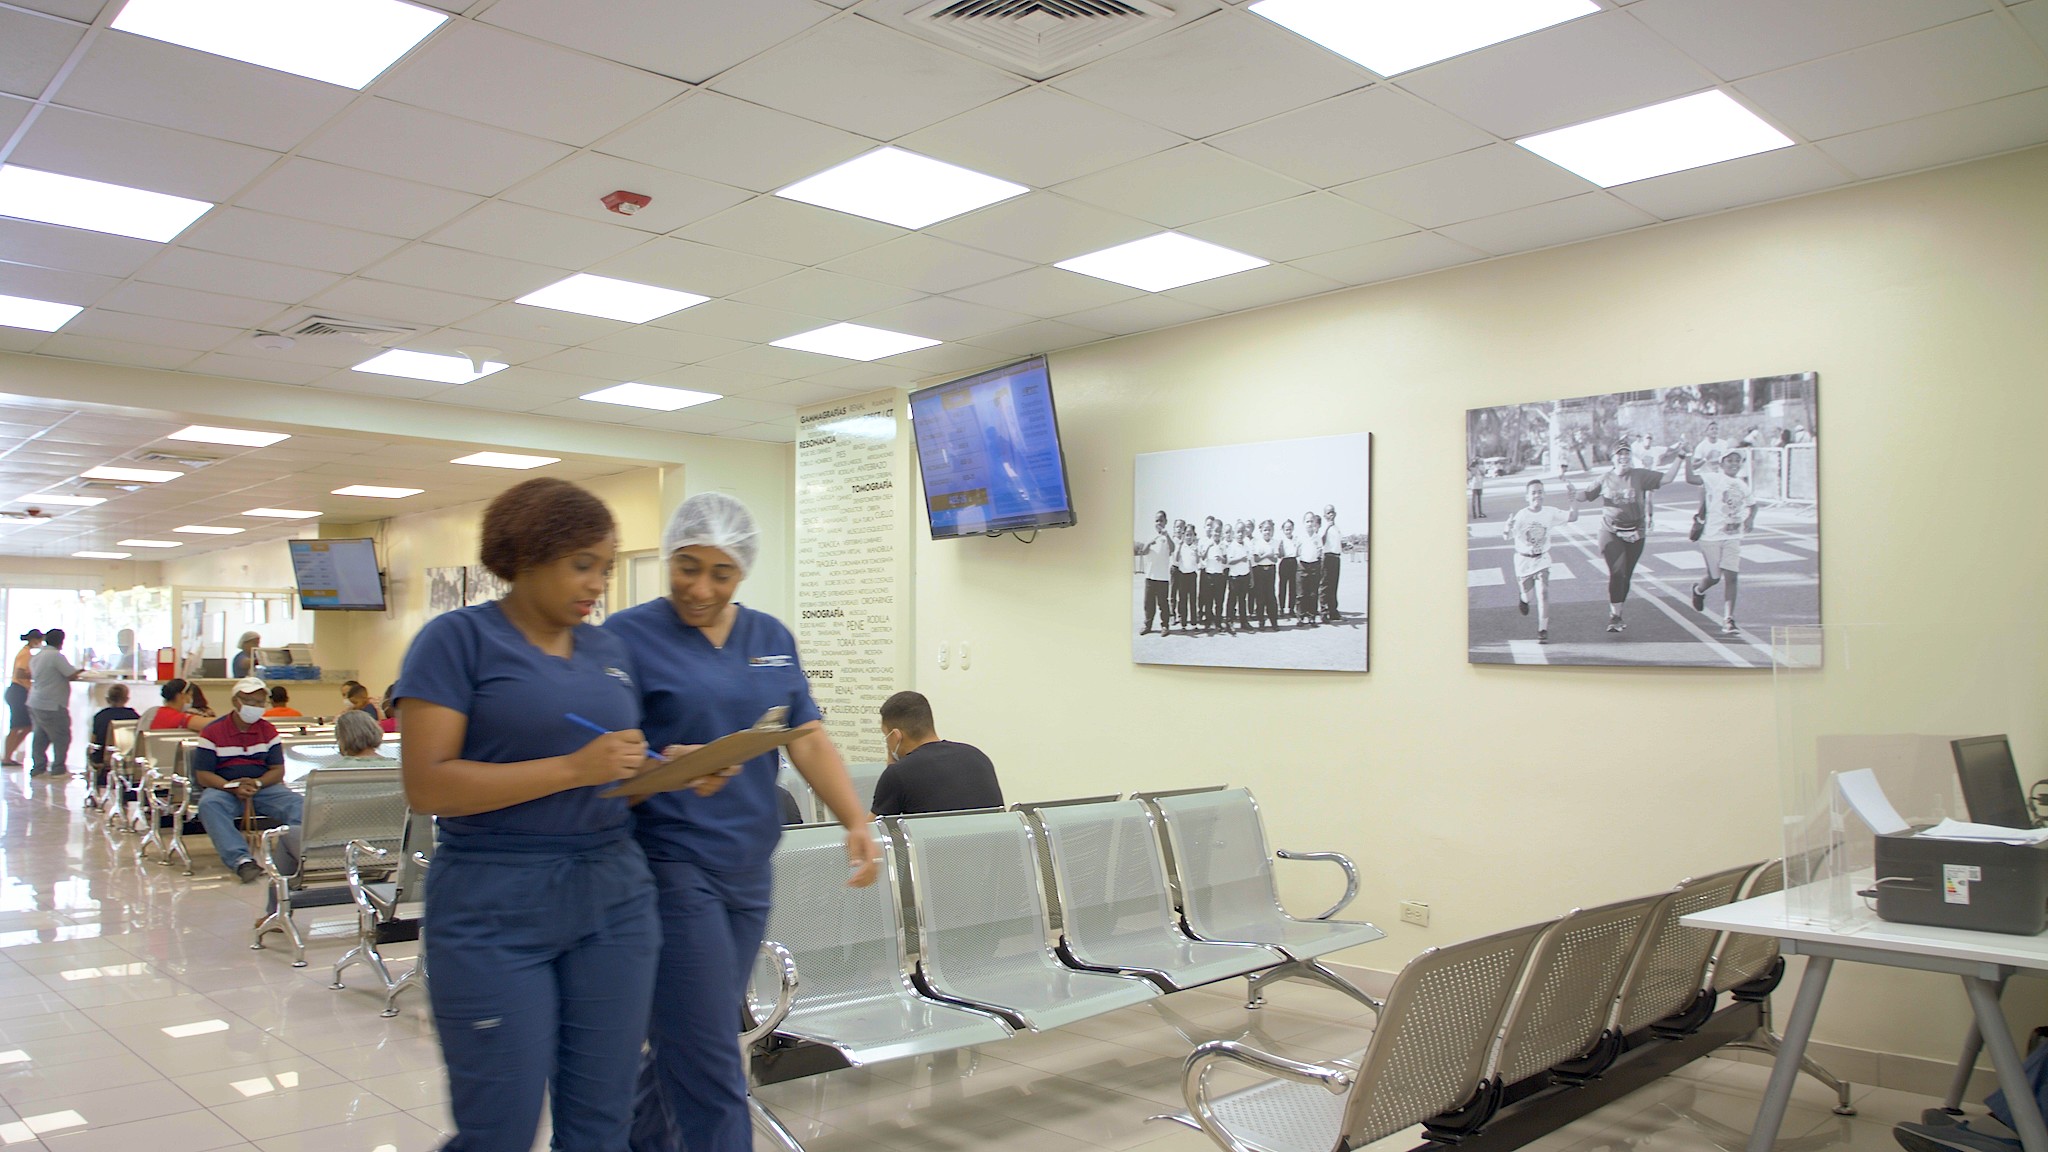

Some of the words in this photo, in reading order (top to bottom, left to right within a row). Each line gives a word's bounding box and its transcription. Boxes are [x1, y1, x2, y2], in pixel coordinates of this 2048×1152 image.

[886, 408, 893, 417] CT
[799, 435, 837, 449] RESONANCIA
[852, 478, 893, 493] TOMOGRAFÍA
[874, 510, 894, 519] CUELLO
[802, 607, 845, 619] SONOGRAFÍA
[867, 615, 890, 624] RODILLA
[846, 620, 865, 631] PENE
[802, 670, 833, 678] DOPPLERS
